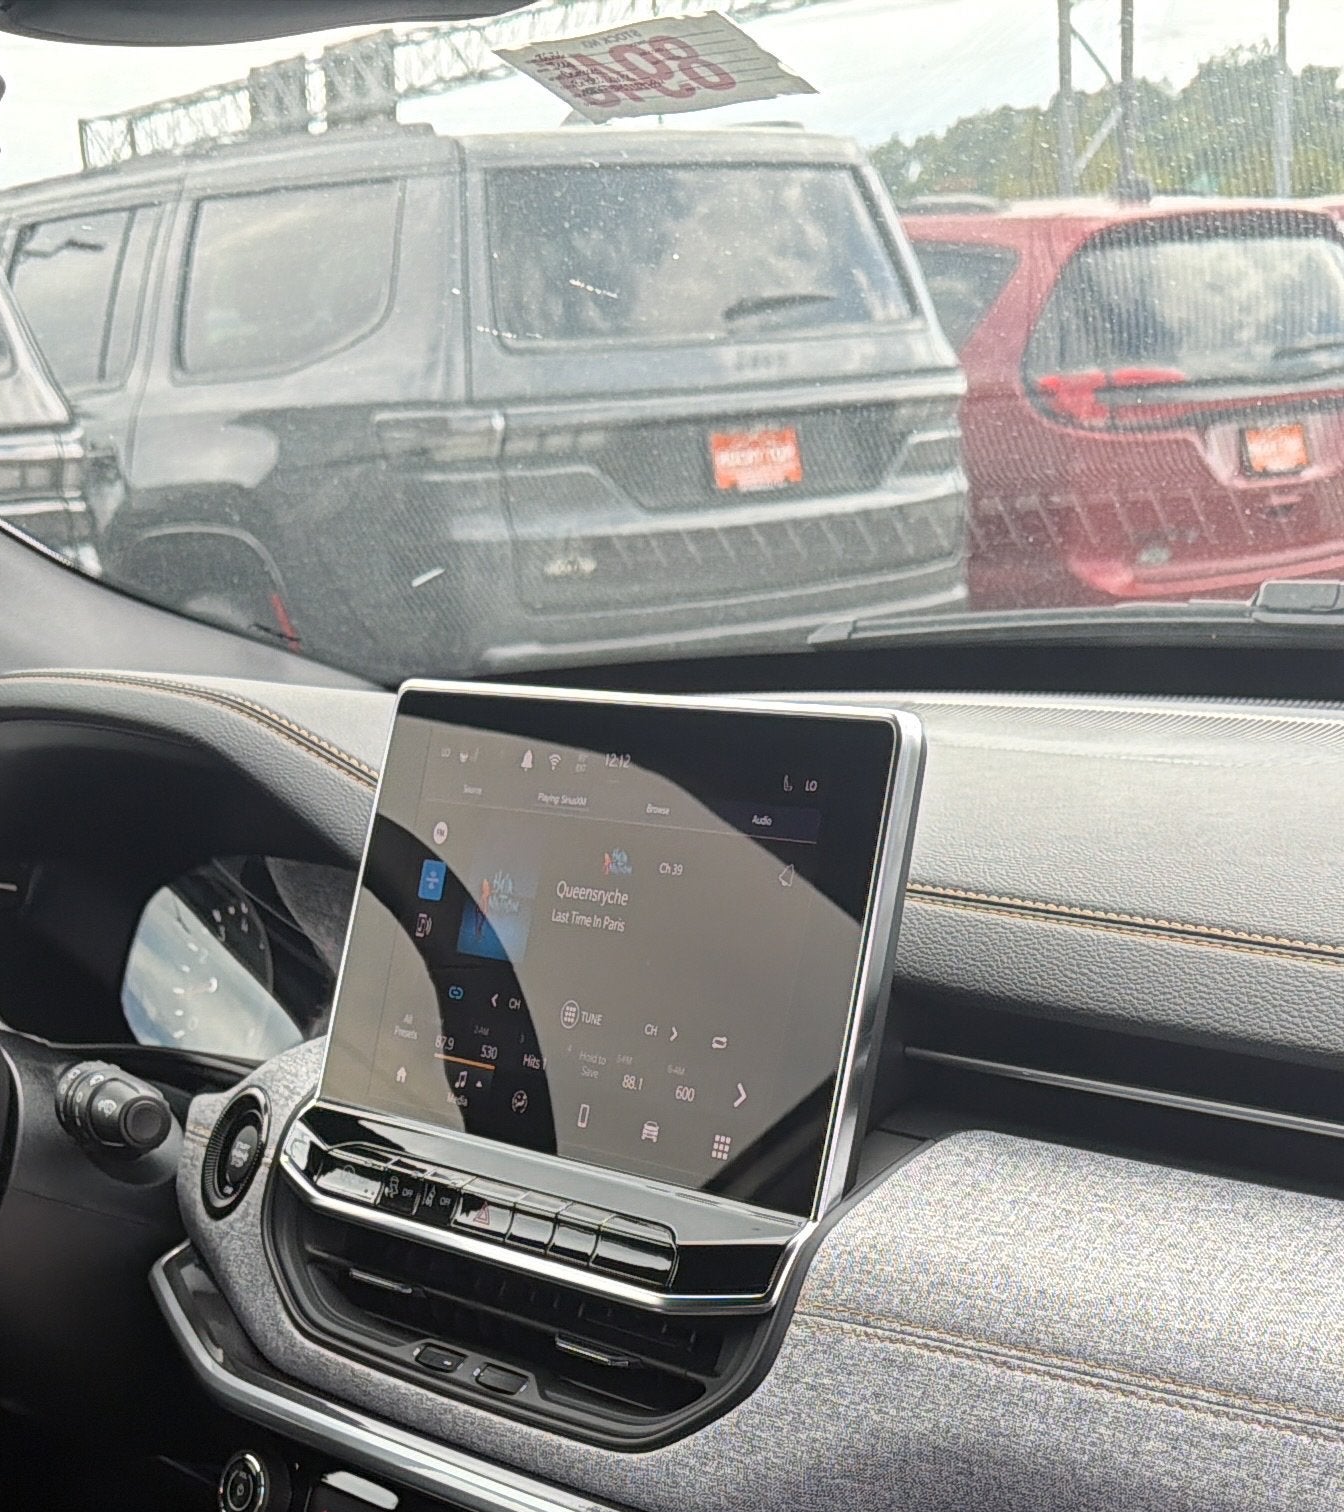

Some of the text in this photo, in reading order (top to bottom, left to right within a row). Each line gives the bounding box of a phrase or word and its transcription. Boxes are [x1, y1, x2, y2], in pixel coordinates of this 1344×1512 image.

[606, 753, 631, 769] 12:12
[805, 780, 818, 791] LO
[537, 792, 560, 805] Playing
[646, 804, 670, 815] Browse
[752, 814, 773, 827] Audio
[659, 862, 683, 875] Ch 39
[556, 880, 629, 906] Queensryche
[551, 909, 625, 932] Last Time In Paris
[508, 998, 521, 1010] CH
[581, 1011, 603, 1026] TUNE
[644, 1023, 658, 1036] CH
[435, 1034, 455, 1051] 87.9
[480, 1045, 498, 1059] 530
[523, 1053, 541, 1070] Hits
[581, 1065, 599, 1078] Save
[622, 1074, 643, 1090] 88.1
[447, 1091, 468, 1107] Media
[675, 1085, 695, 1102] 600
